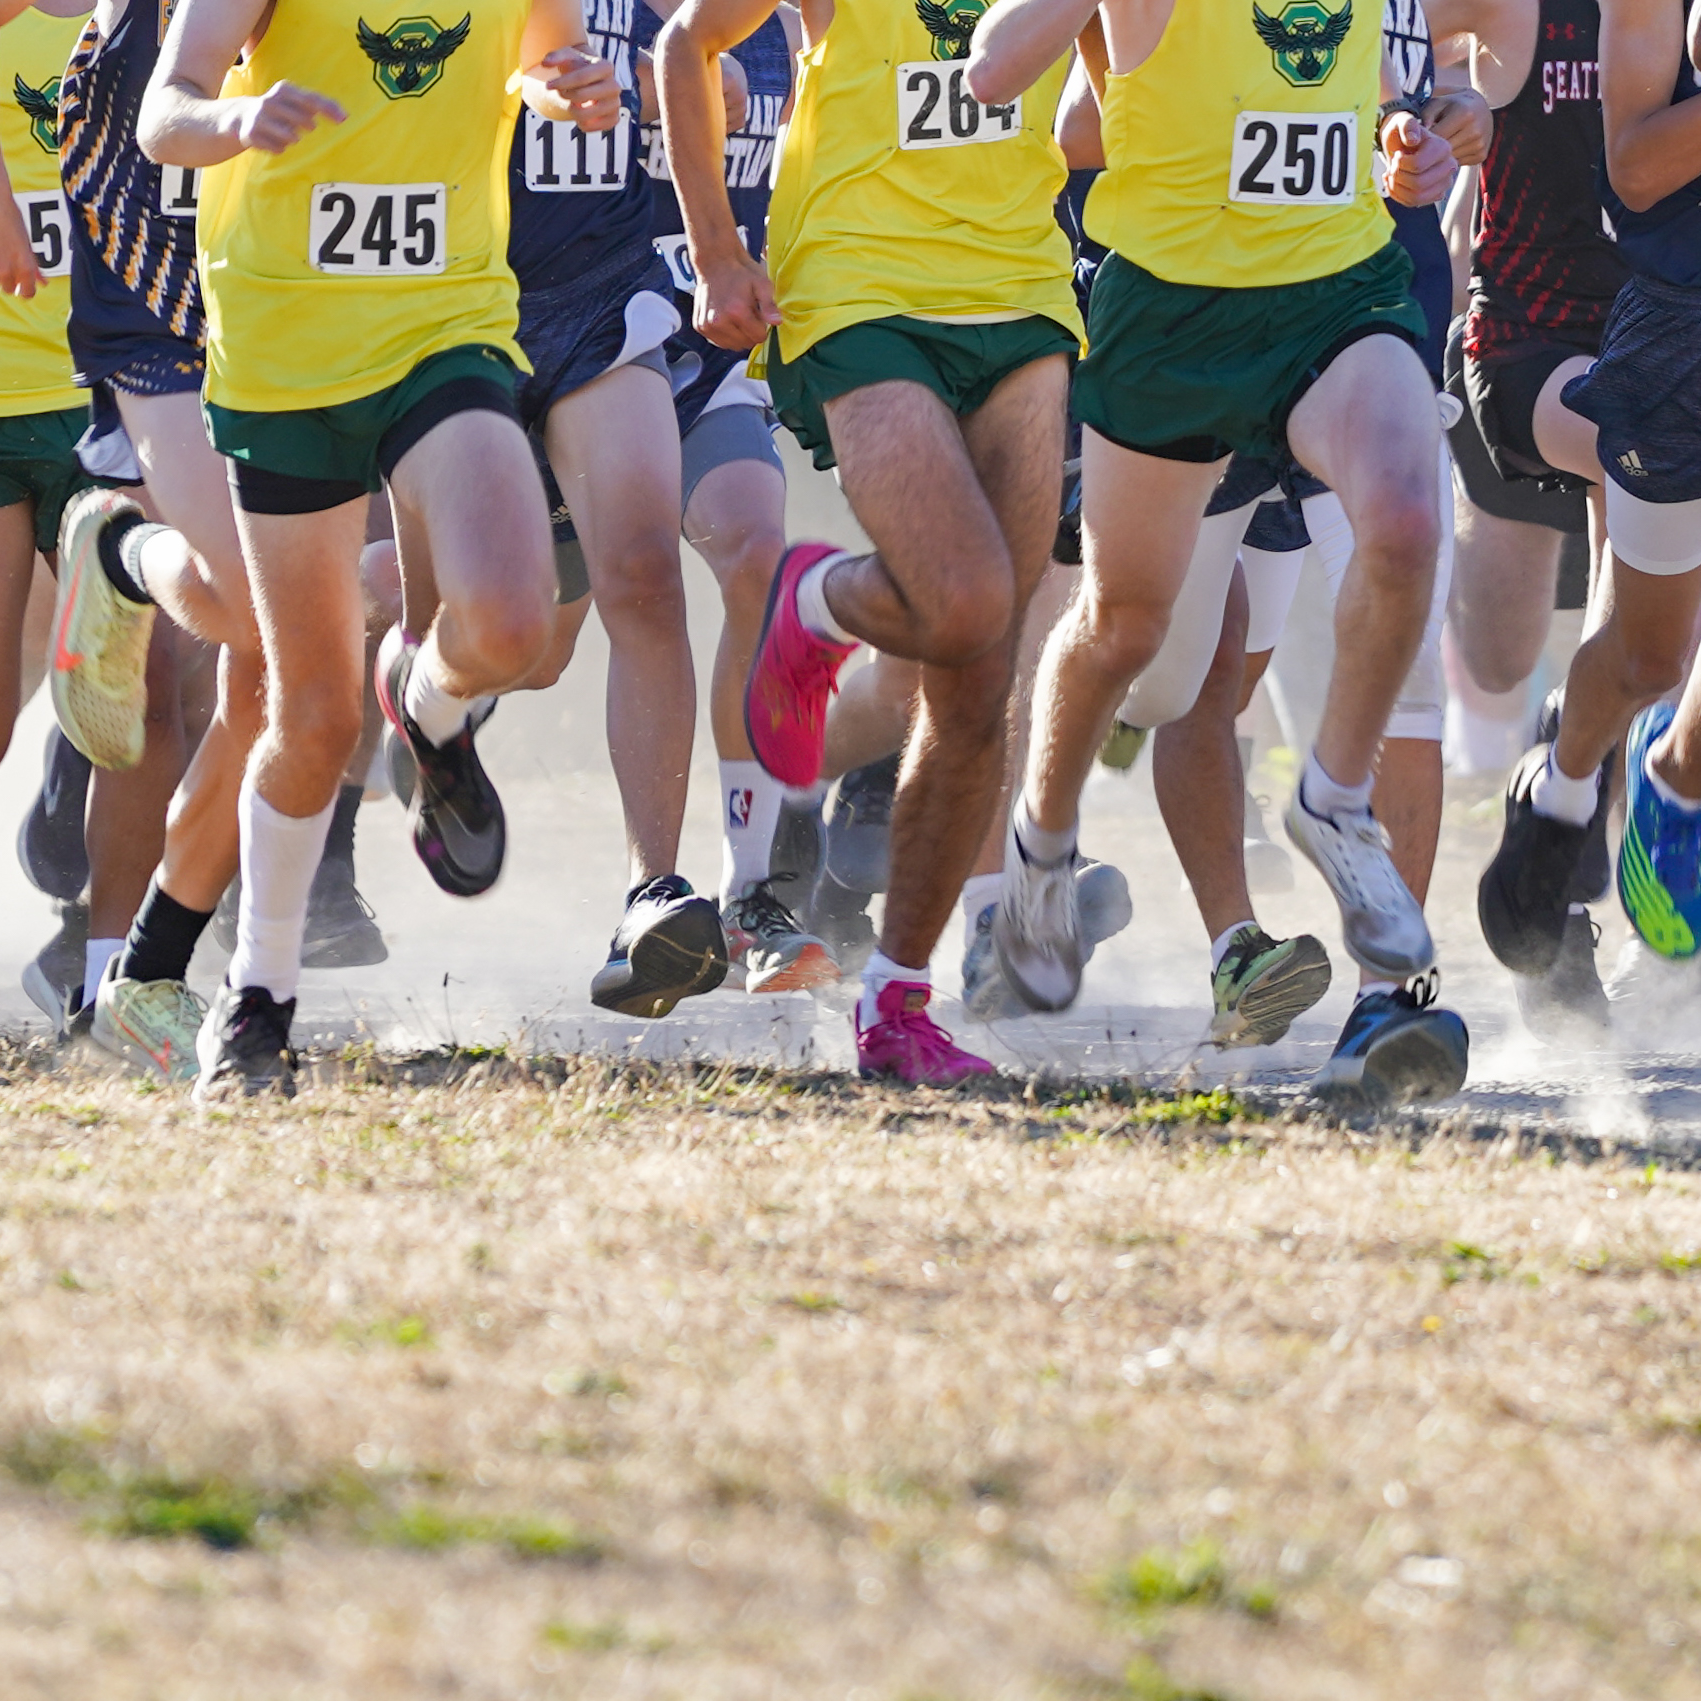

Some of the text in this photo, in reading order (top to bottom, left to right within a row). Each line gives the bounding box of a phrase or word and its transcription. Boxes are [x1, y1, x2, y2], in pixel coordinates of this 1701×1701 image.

[535, 120, 619, 186] 111
[1238, 120, 1348, 196] 250
[318, 191, 437, 267] 245
